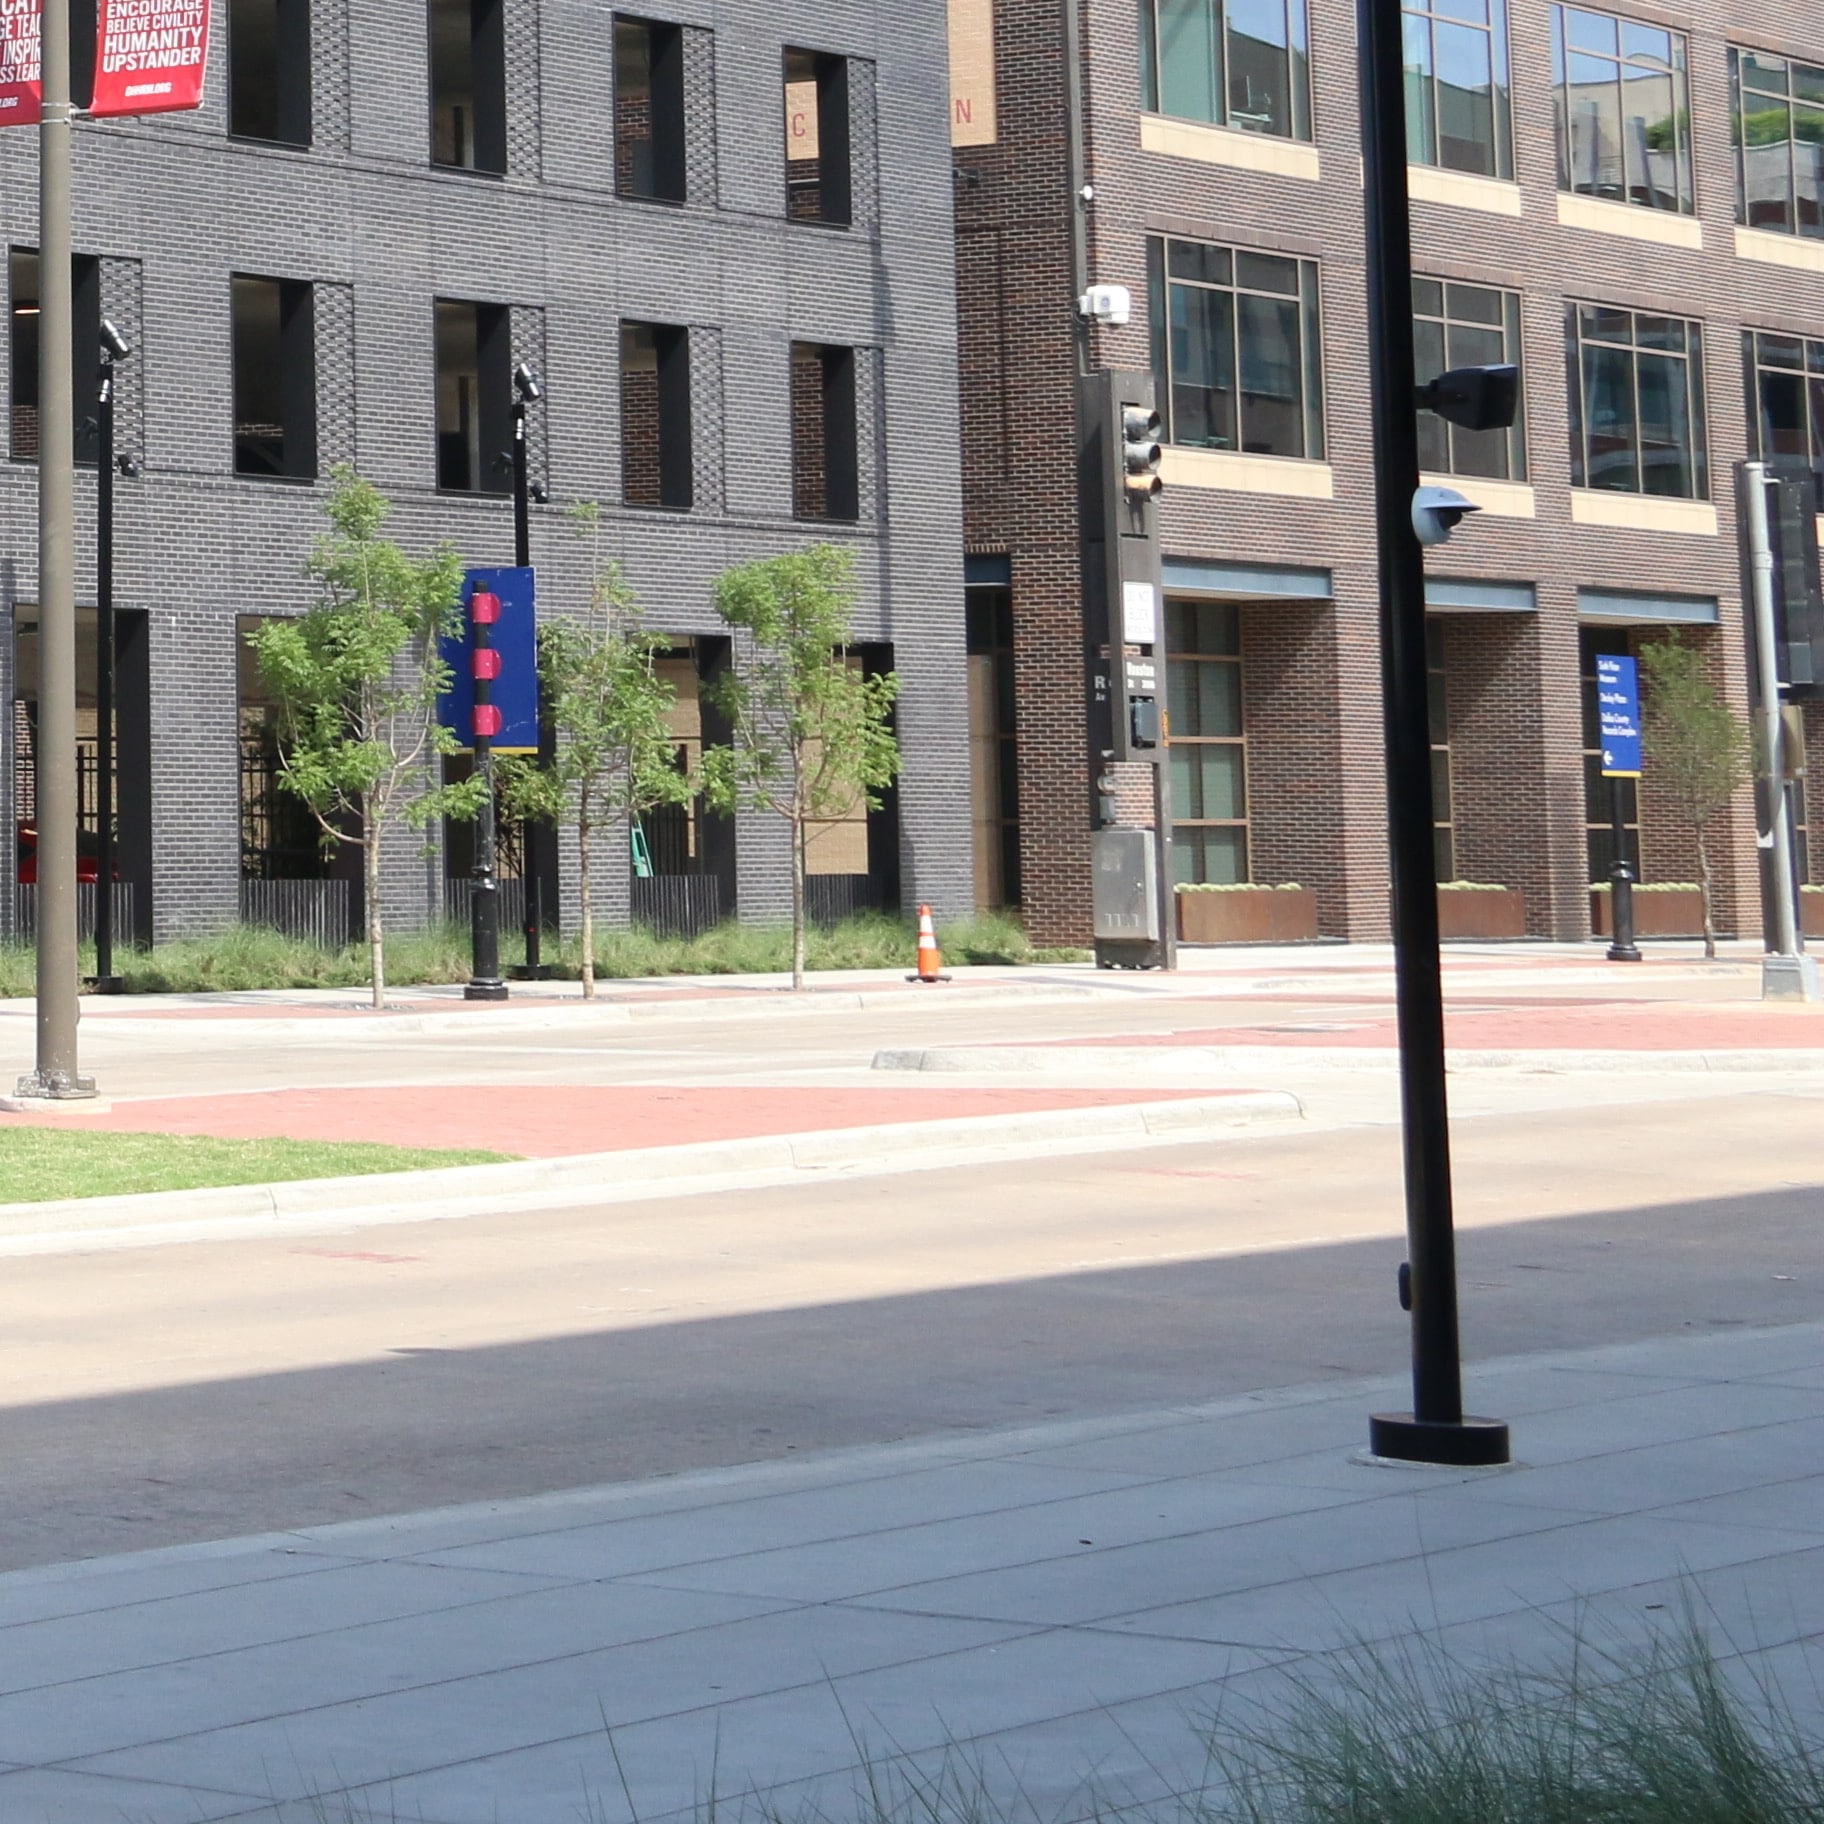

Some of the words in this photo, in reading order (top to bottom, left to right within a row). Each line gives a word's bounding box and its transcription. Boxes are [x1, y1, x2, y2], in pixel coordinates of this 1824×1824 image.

[106, 16, 150, 34] BELIEVE
[152, 10, 204, 29] CIVILITY
[104, 26, 203, 55] HUMANITY
[103, 46, 201, 73] UPSTANDER
[16, 63, 41, 83] LEAR
